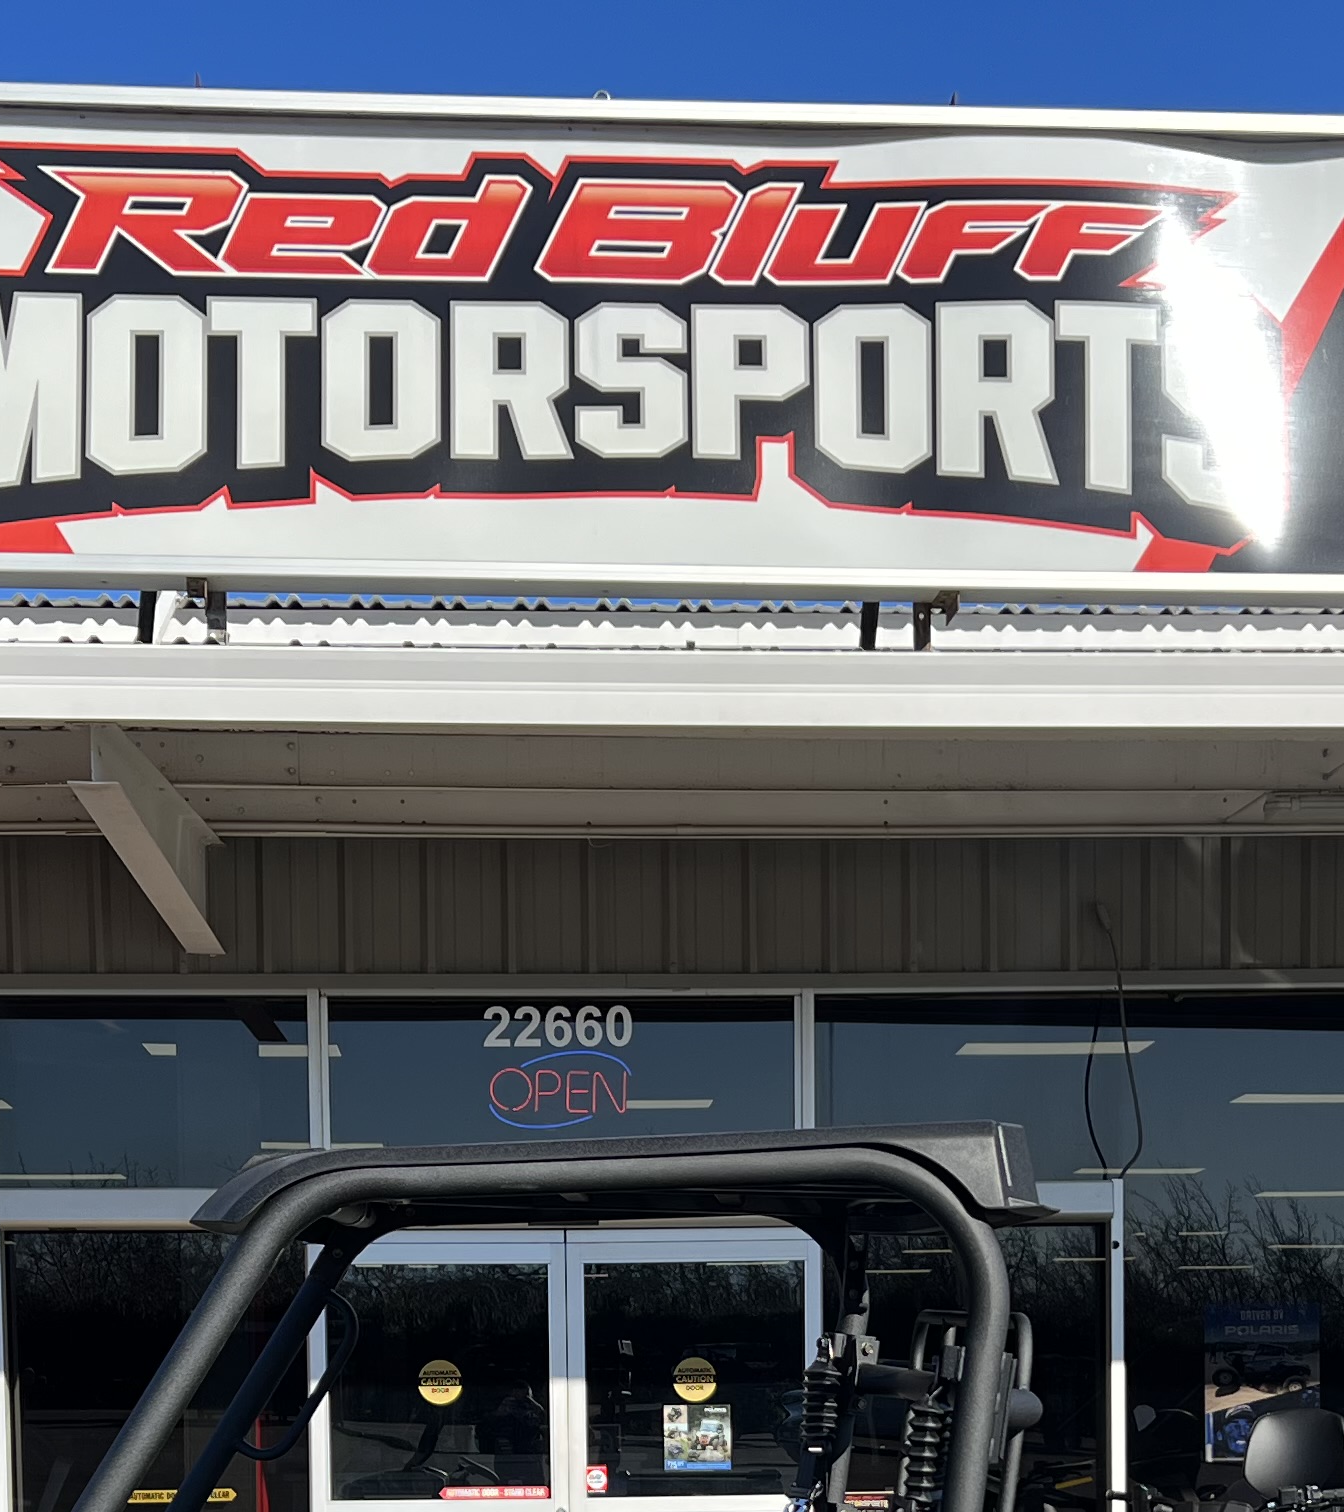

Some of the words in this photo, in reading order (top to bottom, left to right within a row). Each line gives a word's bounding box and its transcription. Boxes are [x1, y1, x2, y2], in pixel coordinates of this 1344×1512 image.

[38, 164, 528, 282] Red
[483, 1004, 632, 1048] 22660
[489, 1067, 628, 1114] OPEN
[1224, 1325, 1299, 1337] POLARIS
[420, 1377, 460, 1386] CAUTION
[675, 1375, 714, 1384] CAUTION
